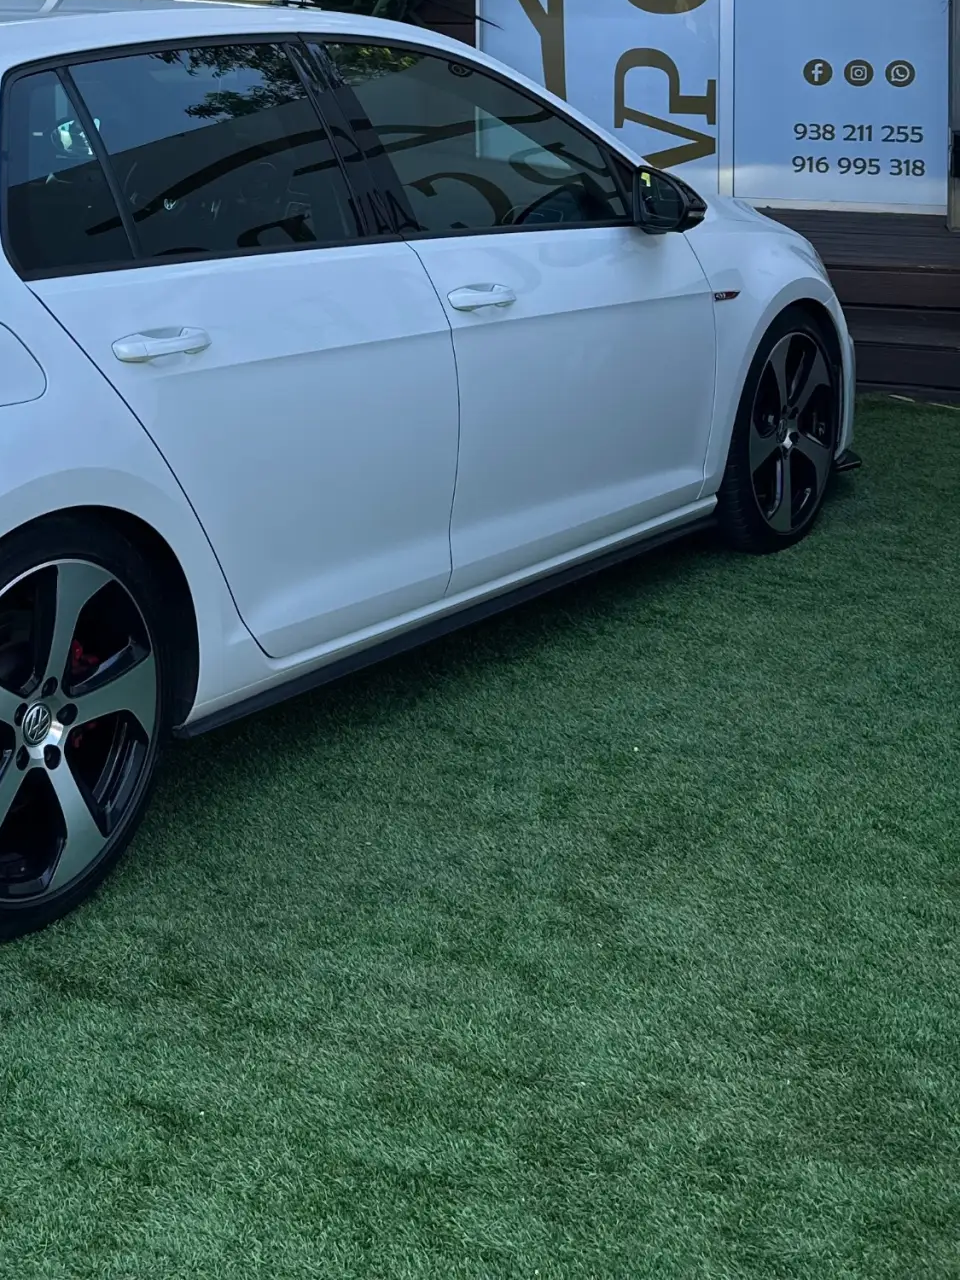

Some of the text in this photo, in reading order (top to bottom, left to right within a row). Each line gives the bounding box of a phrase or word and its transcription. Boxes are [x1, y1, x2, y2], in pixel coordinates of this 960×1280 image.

[614, 47, 717, 169] VP
[793, 123, 924, 143] 938 211 255
[792, 156, 926, 177] 916 995 318
